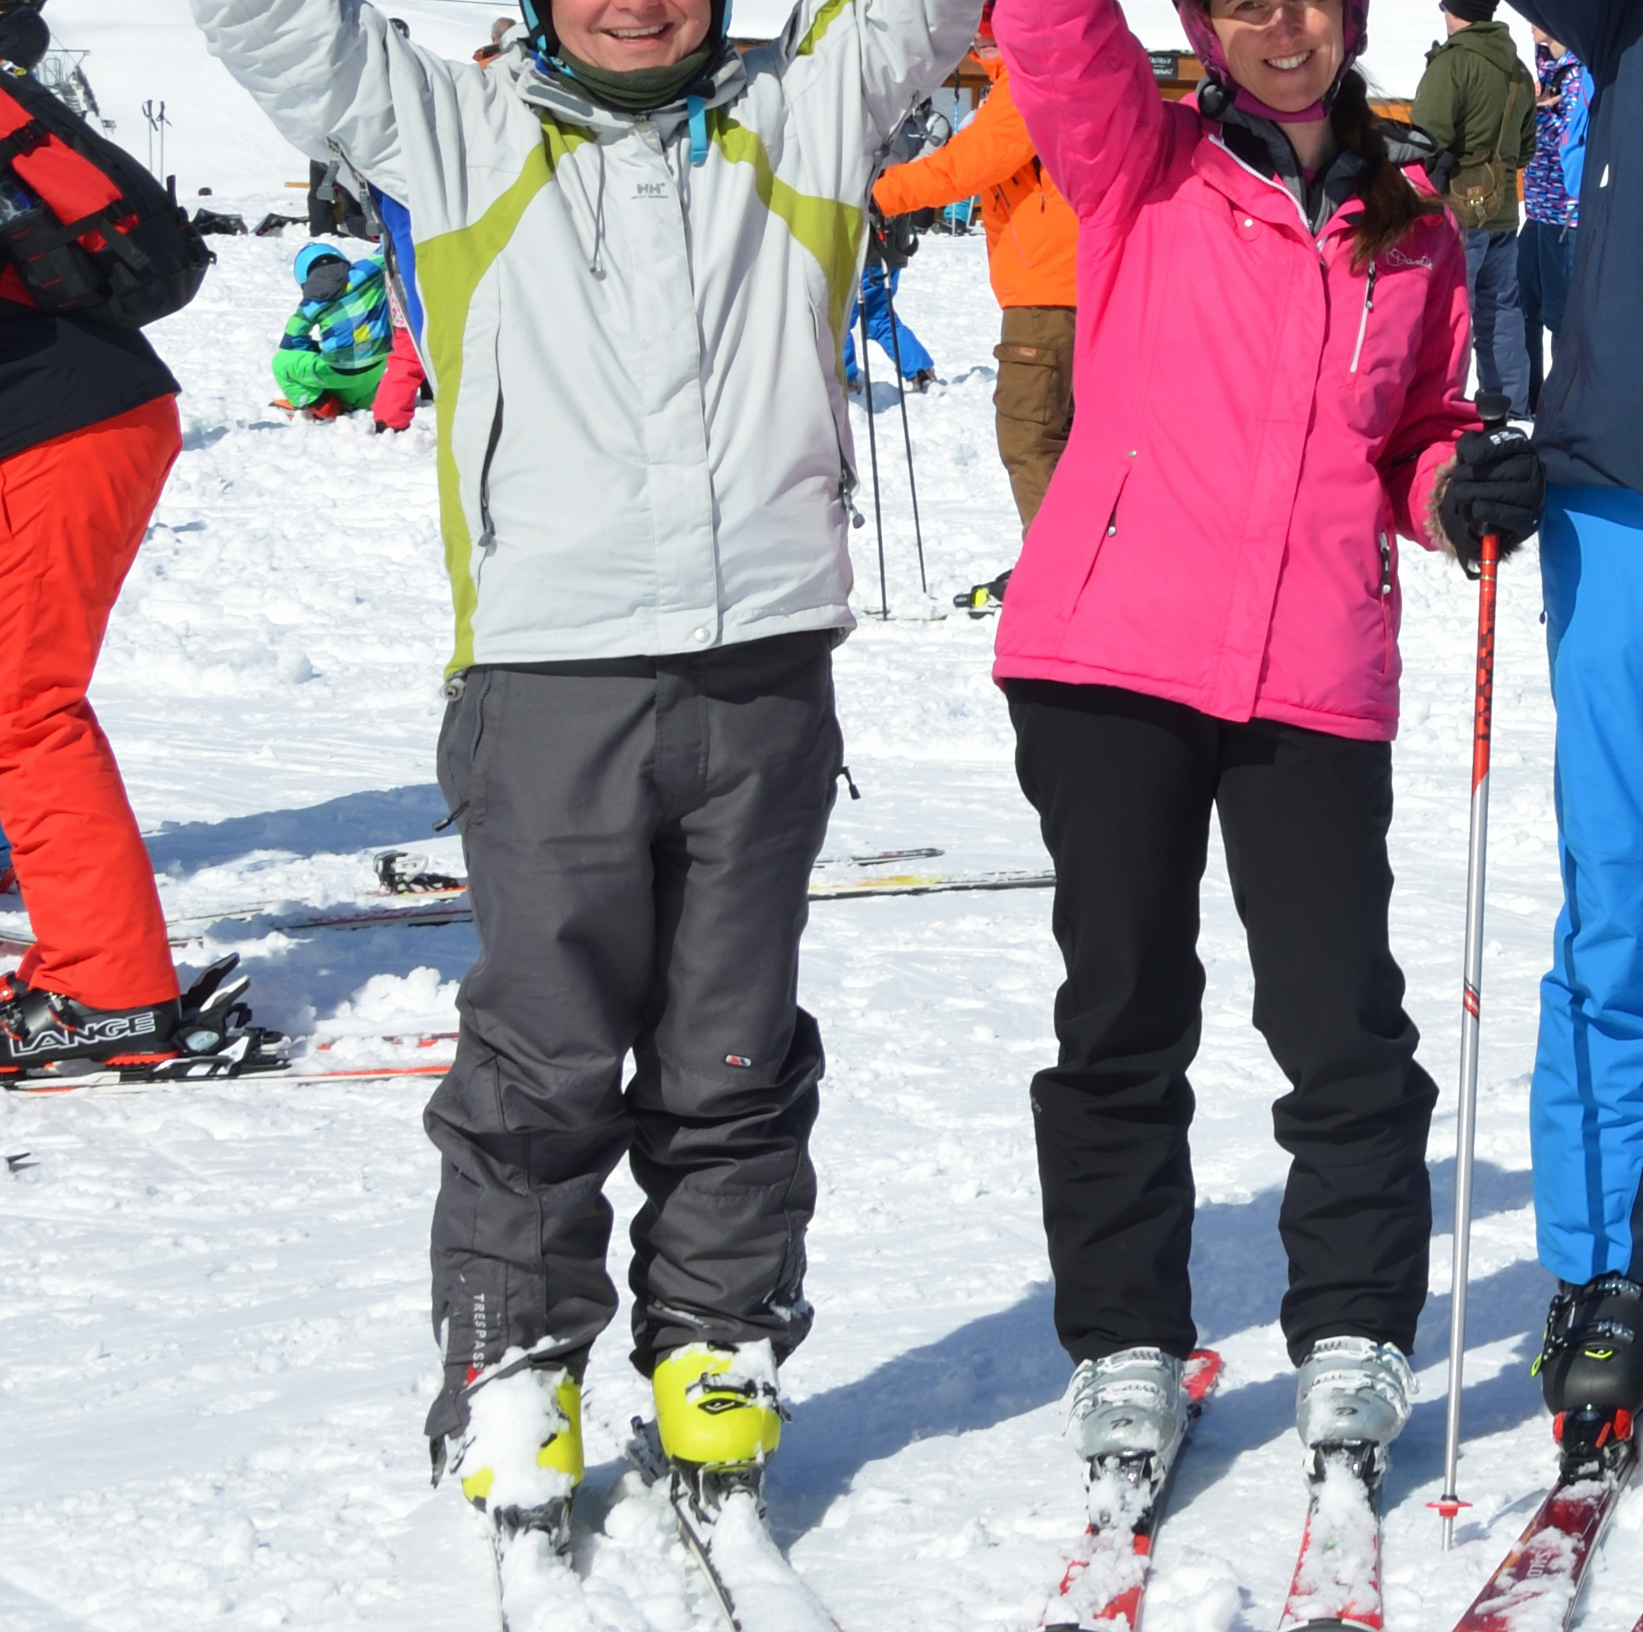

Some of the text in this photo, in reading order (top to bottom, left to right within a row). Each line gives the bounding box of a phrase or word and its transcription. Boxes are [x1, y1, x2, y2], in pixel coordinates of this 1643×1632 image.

[636, 183, 662, 195] HH
[10, 1012, 156, 1057] LANGE
[473, 1293, 487, 1370] TRESPASS
